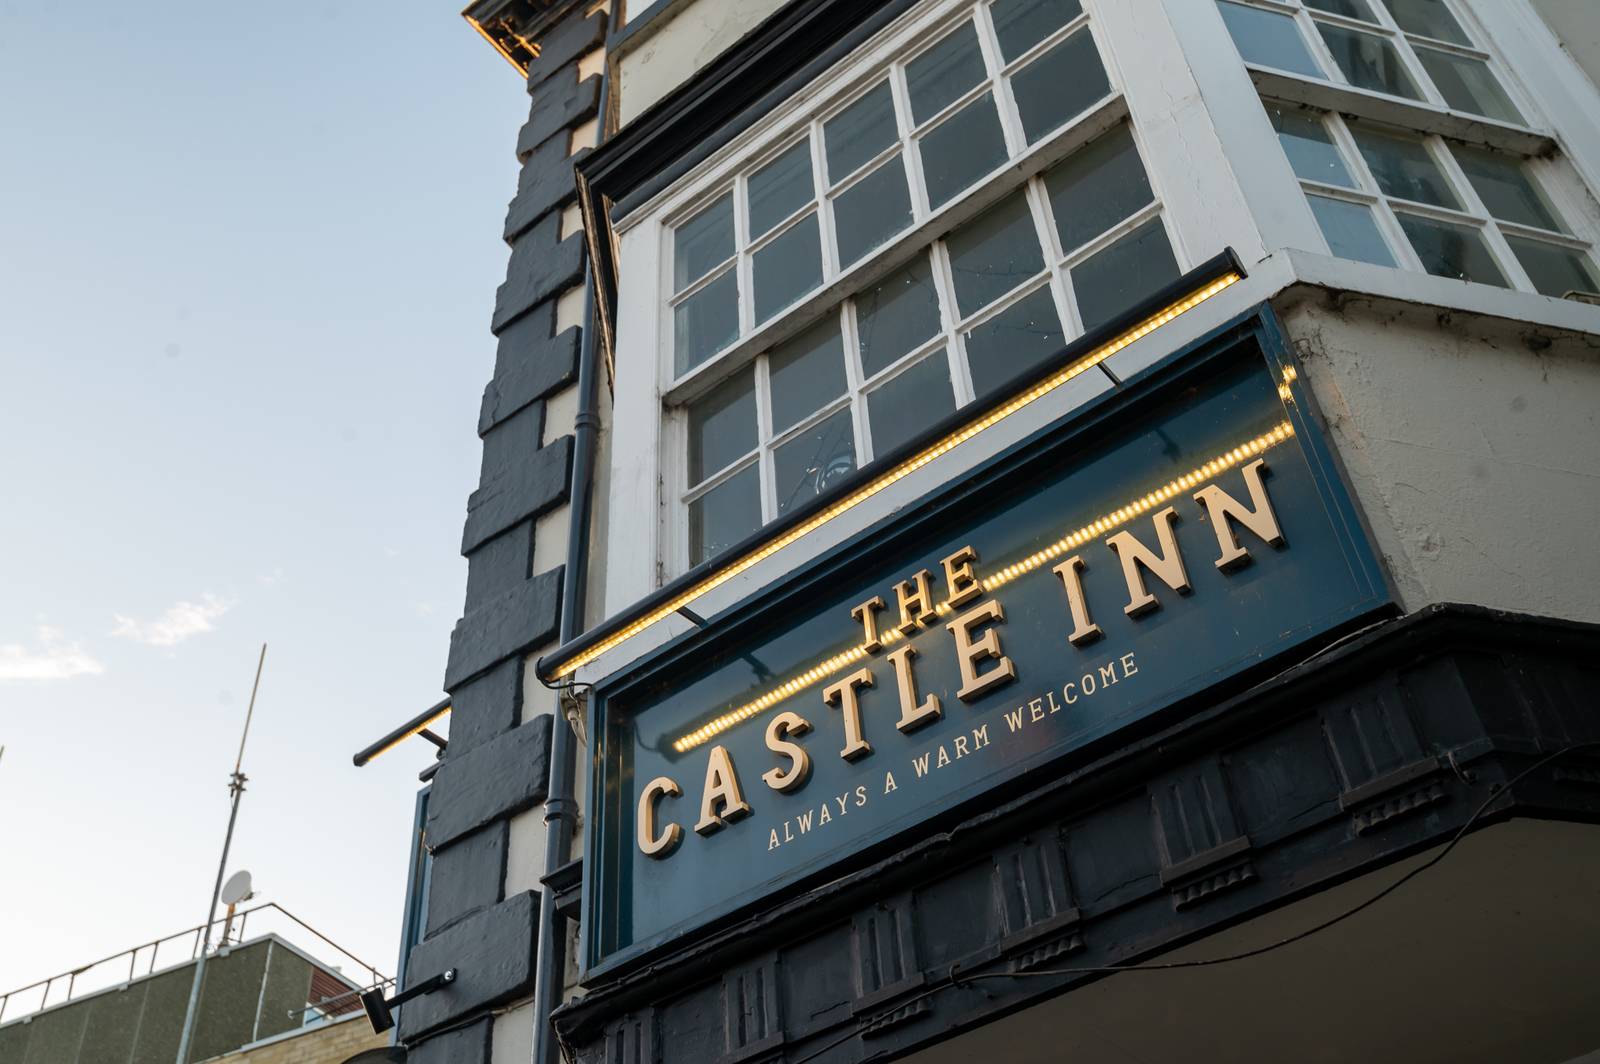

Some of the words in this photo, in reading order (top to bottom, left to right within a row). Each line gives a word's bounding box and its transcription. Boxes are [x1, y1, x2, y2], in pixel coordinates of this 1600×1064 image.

[637, 599, 1016, 858] CASTLE
[1052, 458, 1286, 646] INN
[851, 545, 984, 654] THE
[768, 784, 867, 851] ALWAYS
[883, 770, 899, 794] A
[912, 724, 990, 778] WARM
[1004, 652, 1139, 732] WELCOME
